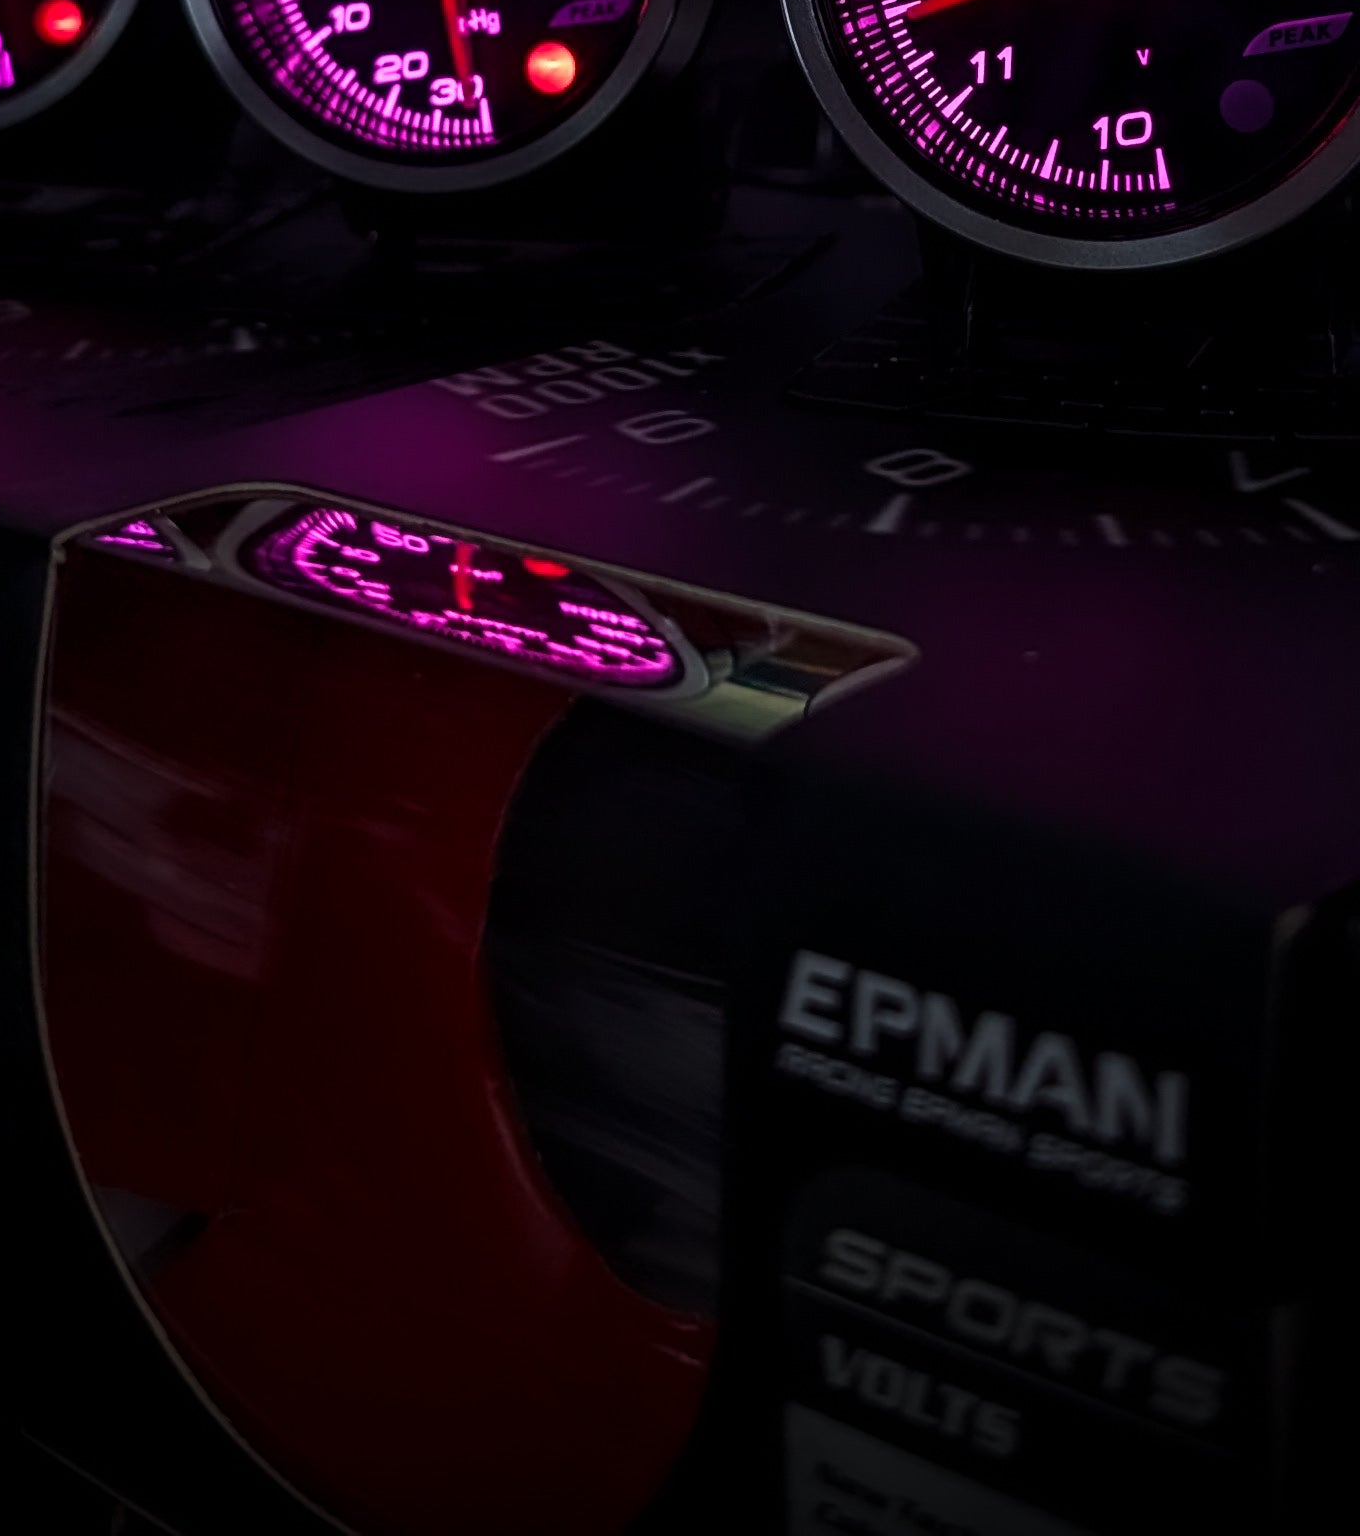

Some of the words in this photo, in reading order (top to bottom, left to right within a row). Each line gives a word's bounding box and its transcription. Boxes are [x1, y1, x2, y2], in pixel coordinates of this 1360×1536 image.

[330, 2, 371, 34] 10
[1269, 21, 1332, 47] PEAK
[373, 51, 429, 84] 20
[969, 46, 1014, 84] 11
[1093, 110, 1154, 150] 10
[777, 947, 1191, 1166] EPMAN
[817, 1226, 1232, 1430] SPORTS
[817, 1333, 1023, 1462] VOLTS
